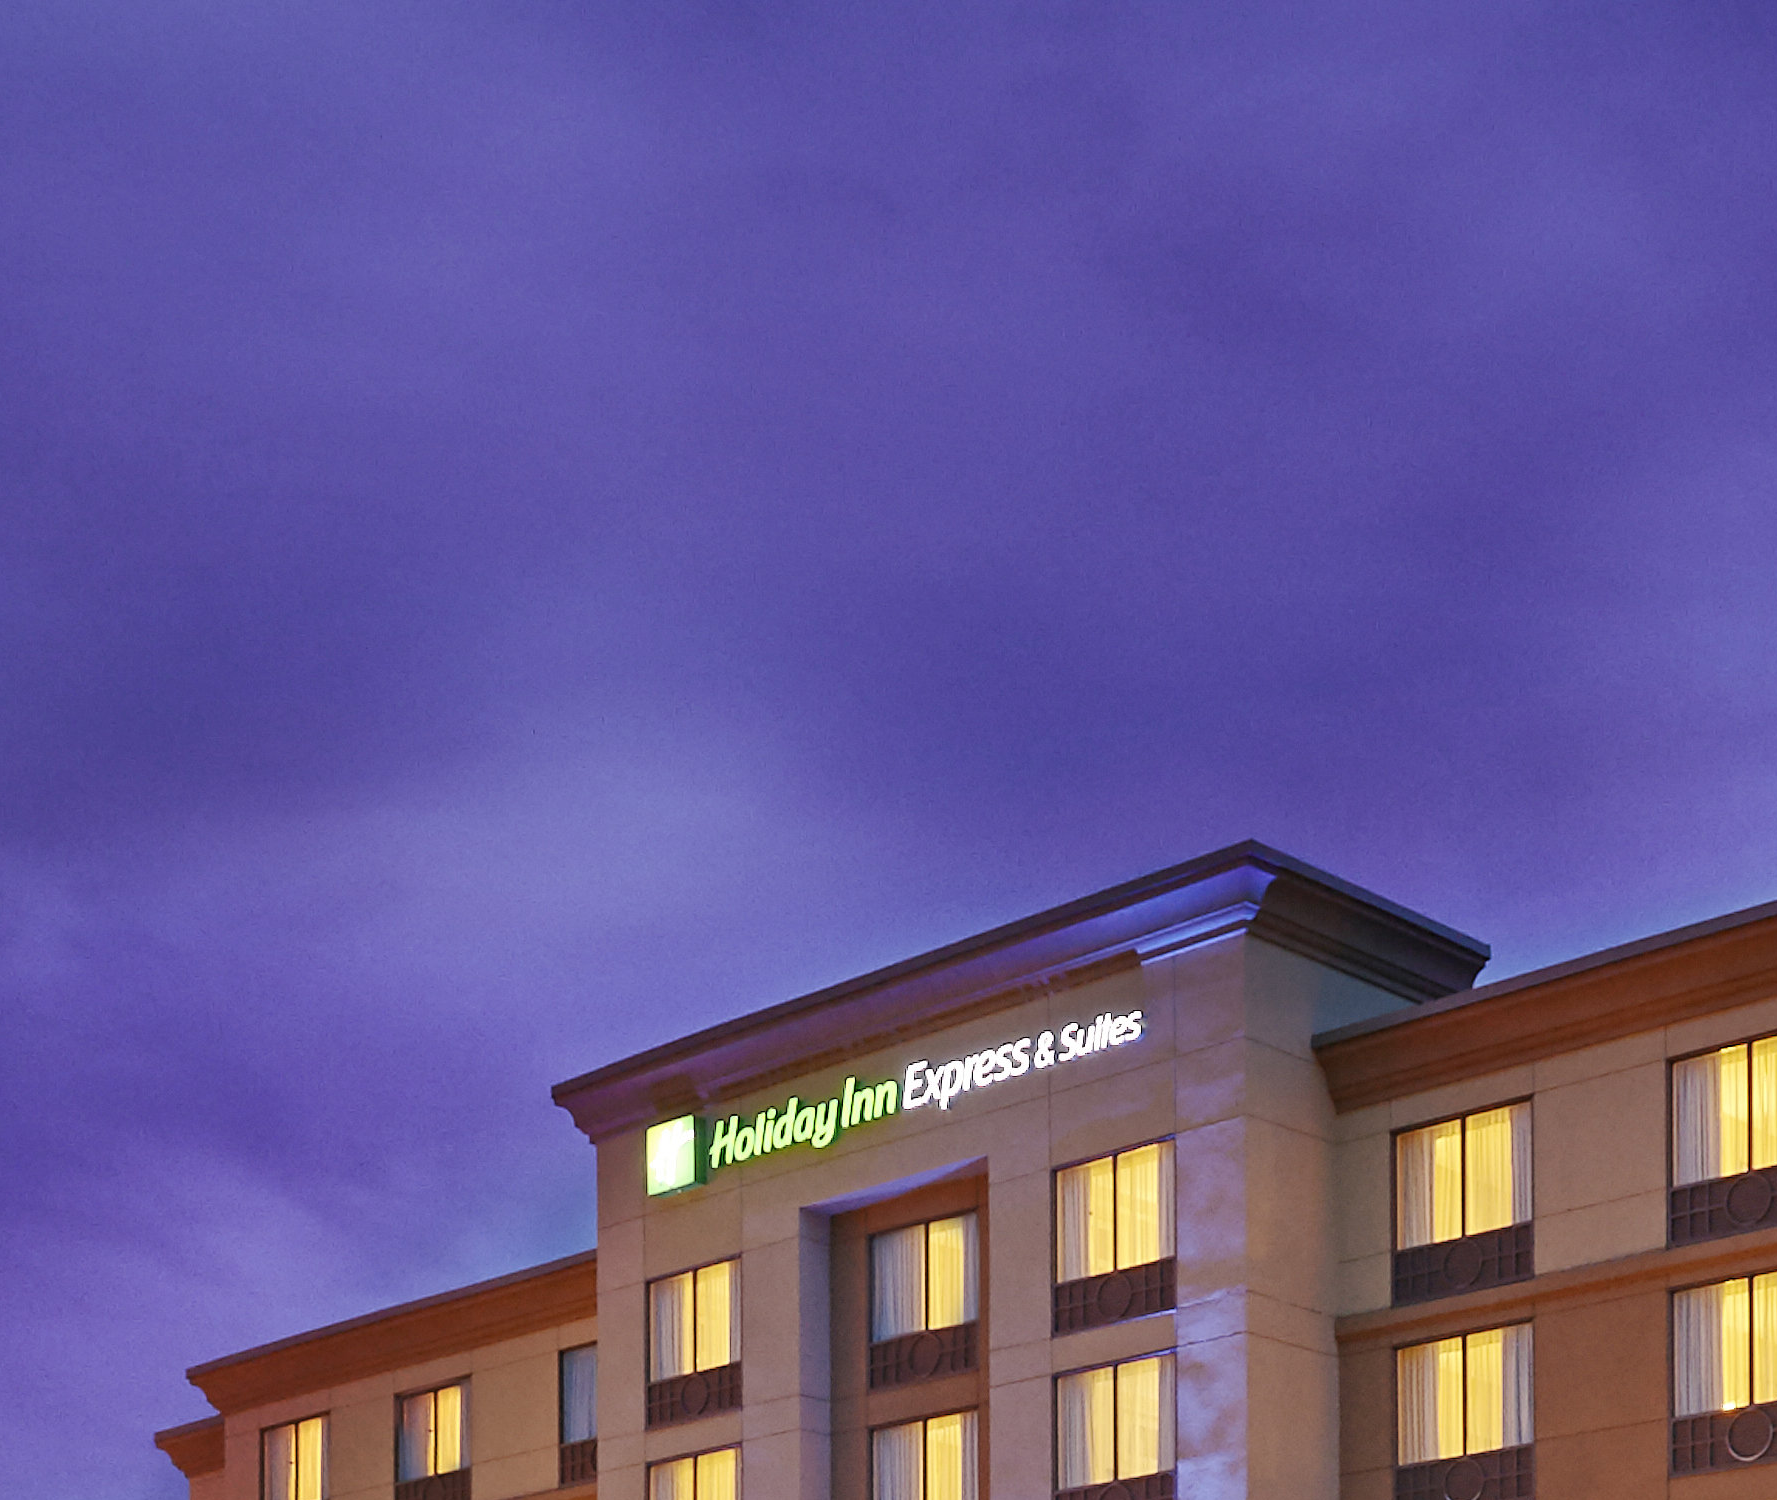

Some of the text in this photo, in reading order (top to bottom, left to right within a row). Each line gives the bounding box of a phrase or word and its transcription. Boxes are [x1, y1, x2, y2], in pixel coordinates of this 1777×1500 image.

[709, 1010, 1142, 1169] Holiday Inn Express & Suites
